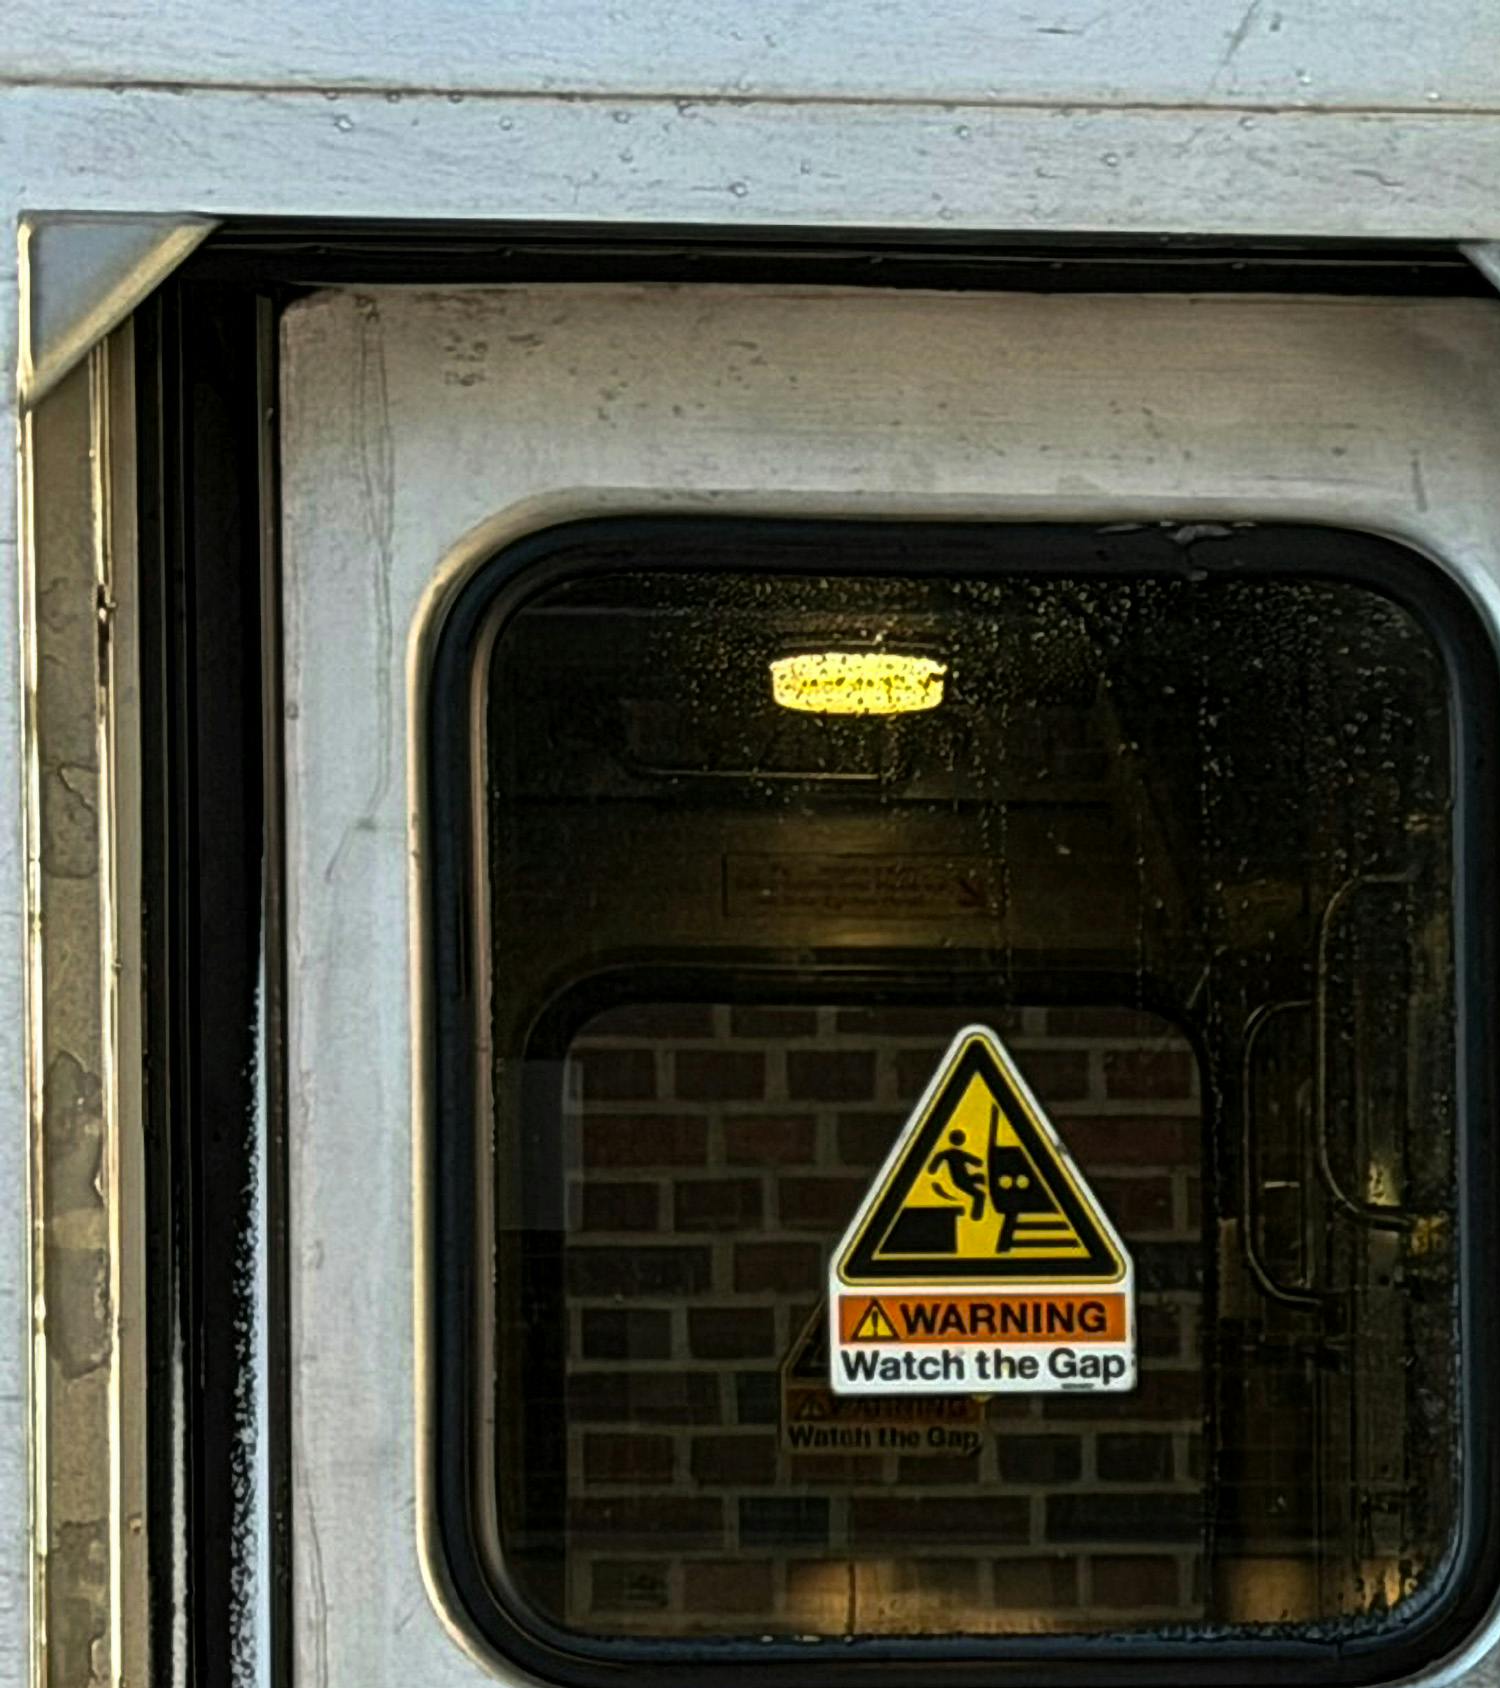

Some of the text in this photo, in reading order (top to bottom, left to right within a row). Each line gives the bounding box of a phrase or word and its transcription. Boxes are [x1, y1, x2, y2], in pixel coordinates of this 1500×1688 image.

[901, 1302, 1107, 1335] WARNING
[840, 1348, 1126, 1385] Watch the Gap
